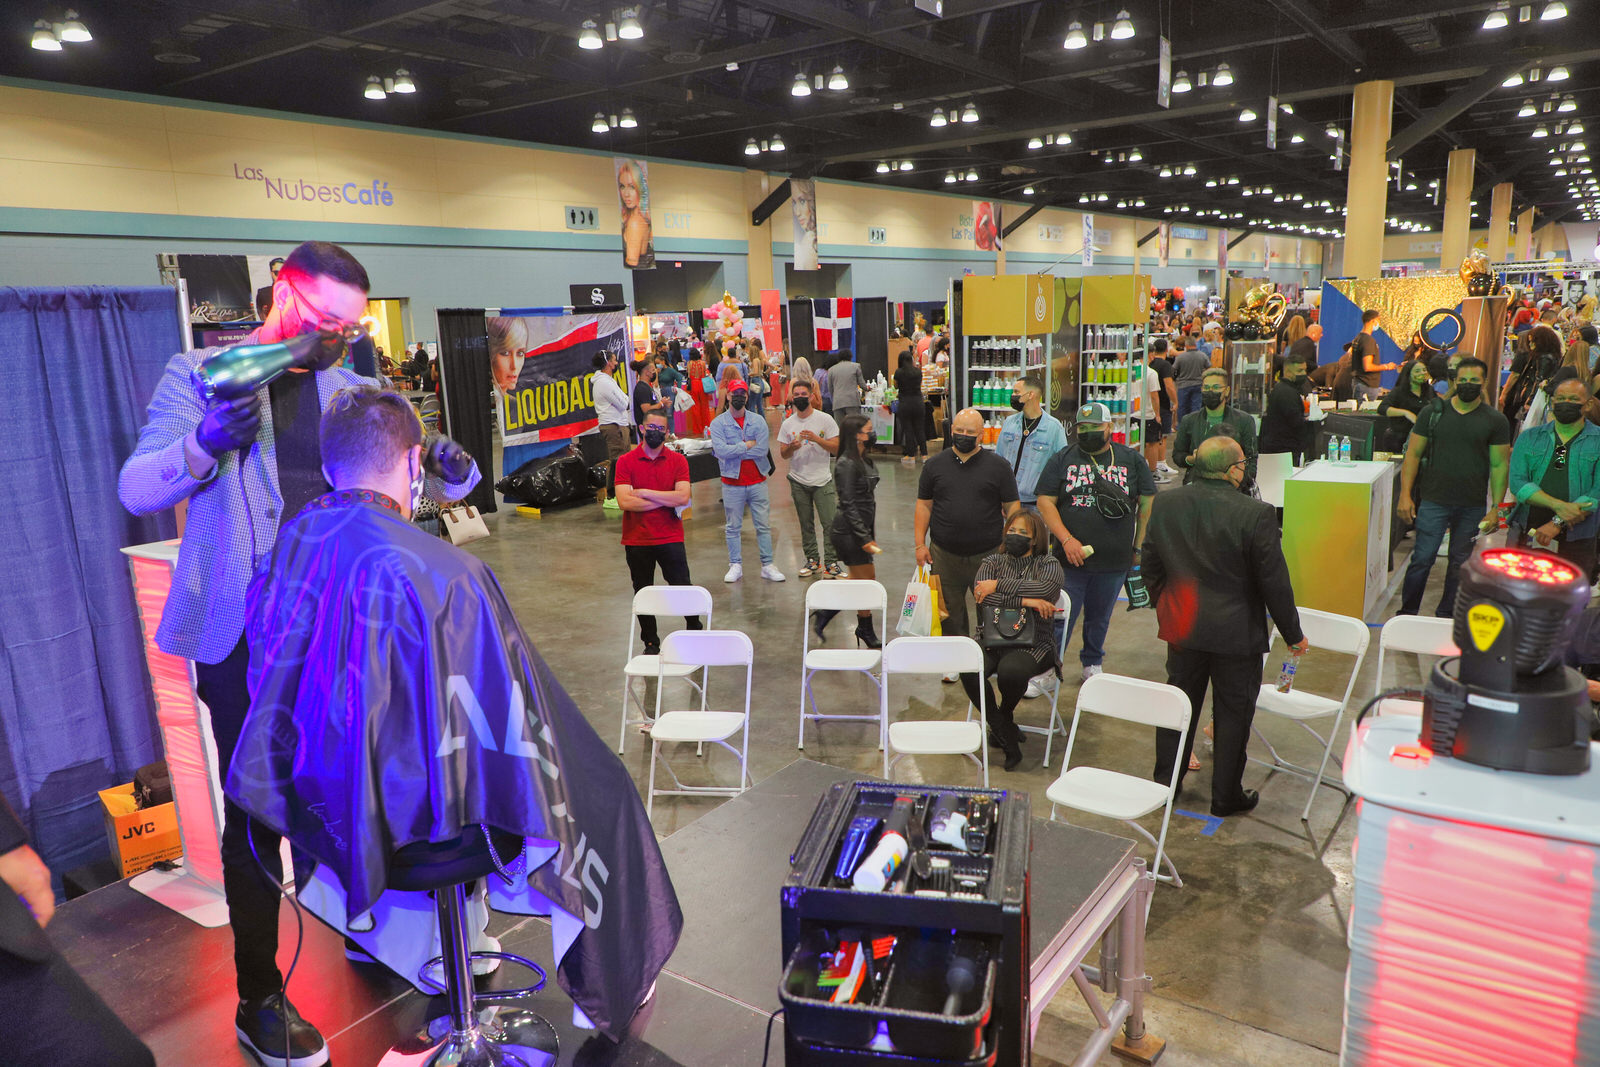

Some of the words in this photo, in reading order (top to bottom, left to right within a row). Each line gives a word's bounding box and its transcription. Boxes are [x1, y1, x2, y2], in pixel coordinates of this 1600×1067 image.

[233, 162, 264, 181] Las
[664, 213, 692, 229] EXIT
[122, 822, 156, 840] JVC
